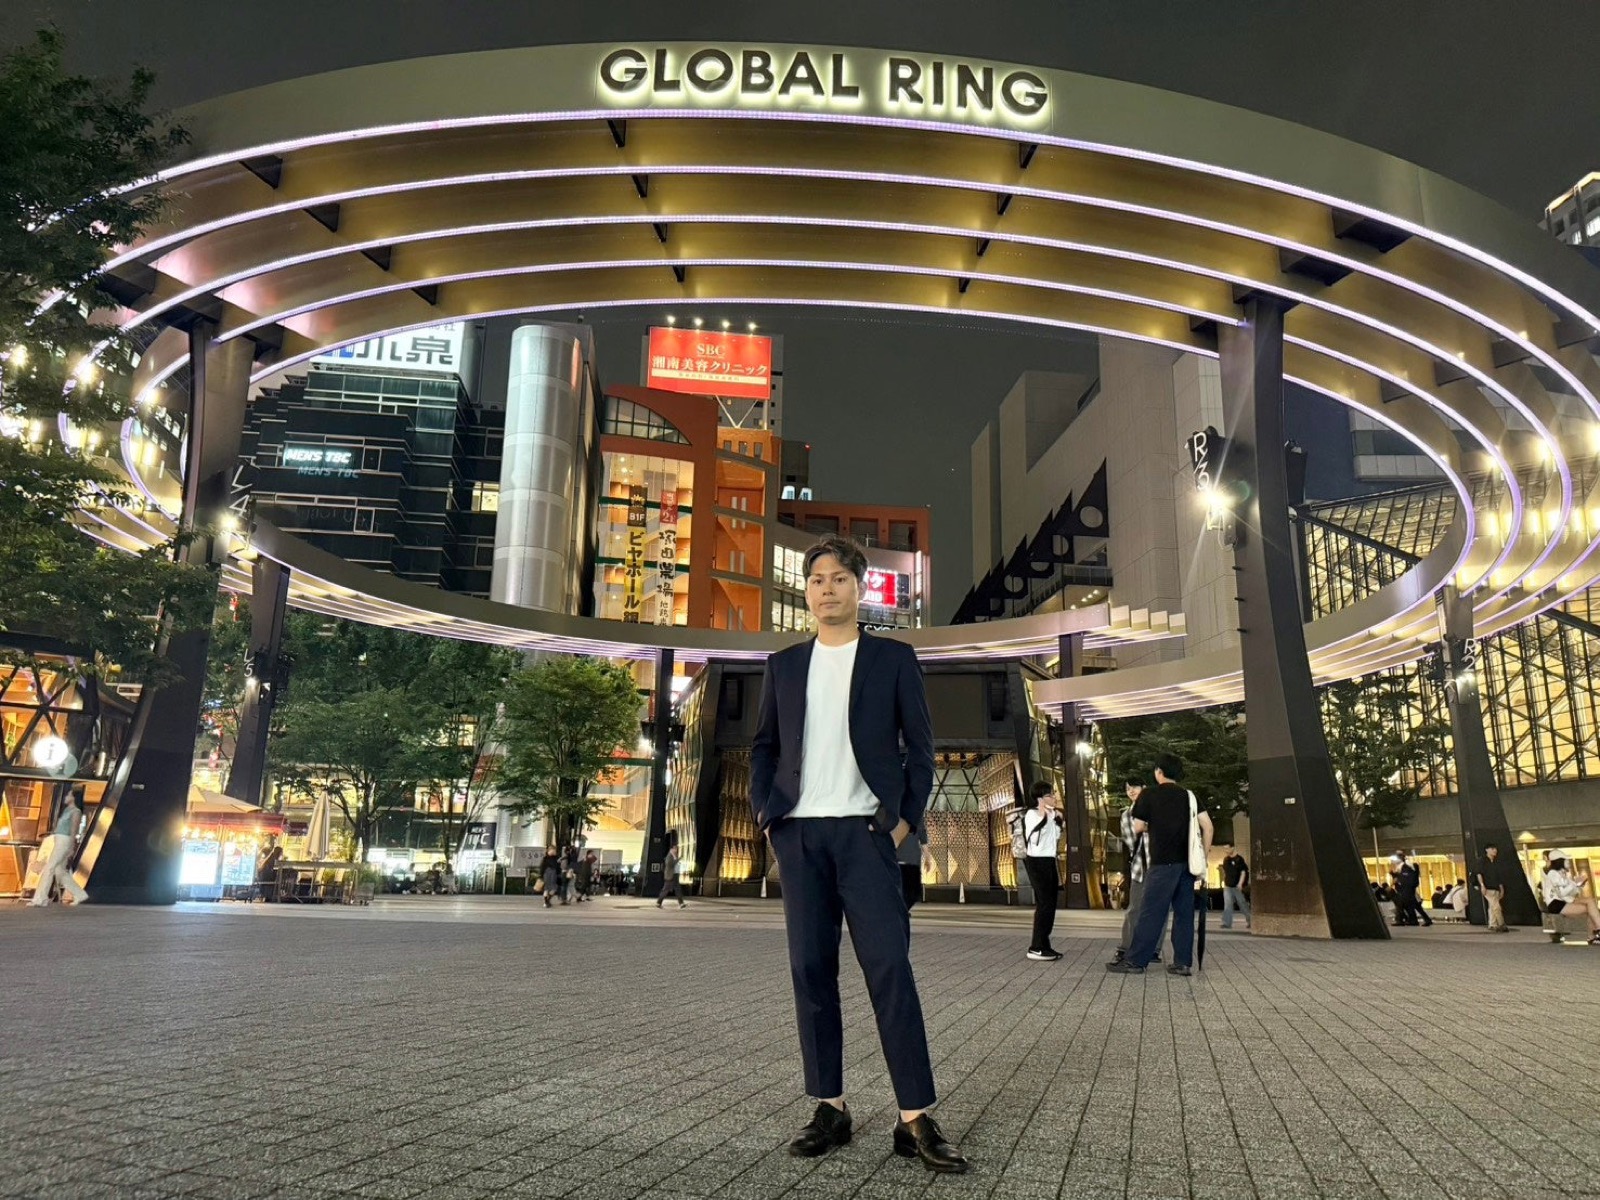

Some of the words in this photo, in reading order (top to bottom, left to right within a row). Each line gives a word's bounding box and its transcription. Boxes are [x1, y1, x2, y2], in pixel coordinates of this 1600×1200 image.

[600, 48, 860, 98] GLOBAL
[888, 57, 1048, 116] RING
[696, 343, 726, 356] SBC
[652, 356, 768, 376] 湘南美容クリニック
[324, 451, 352, 464] TBC
[629, 512, 646, 522] B1F
